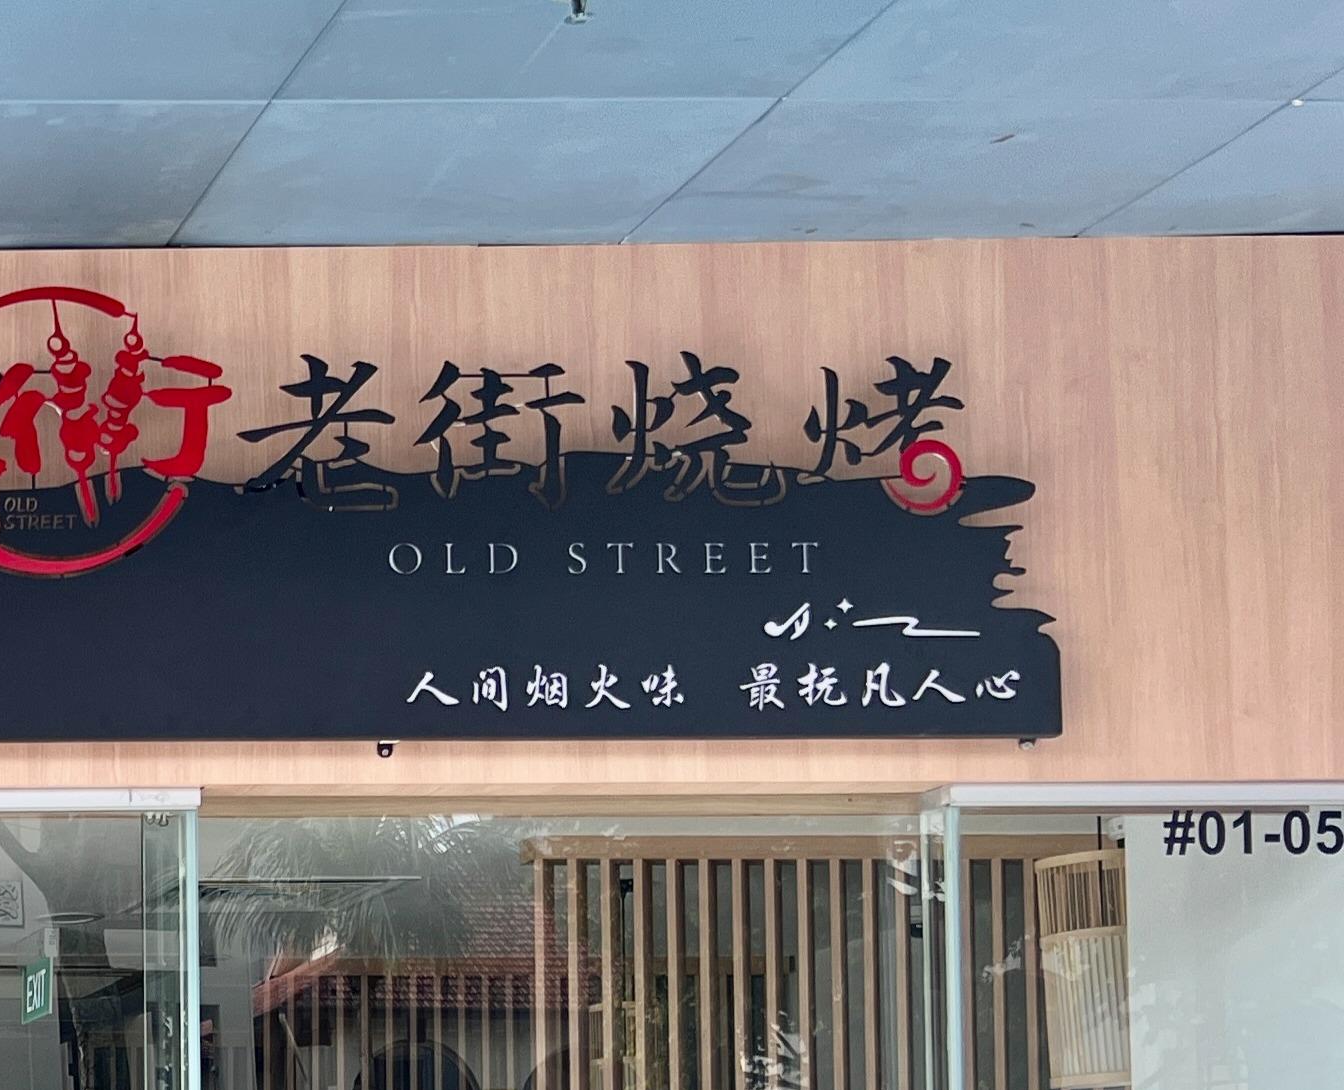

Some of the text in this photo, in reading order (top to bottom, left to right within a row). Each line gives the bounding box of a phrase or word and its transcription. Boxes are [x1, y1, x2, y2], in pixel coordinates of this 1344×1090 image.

[235, 350, 966, 515] 老街烧烤
[4, 497, 38, 512] OLD
[4, 514, 77, 530] STREET
[387, 541, 821, 576] OLD STREET
[406, 661, 1022, 711] 人间烟火味 最抚凡人心
[1163, 809, 1344, 856] #01-05
[26, 969, 47, 1014] EXIT
